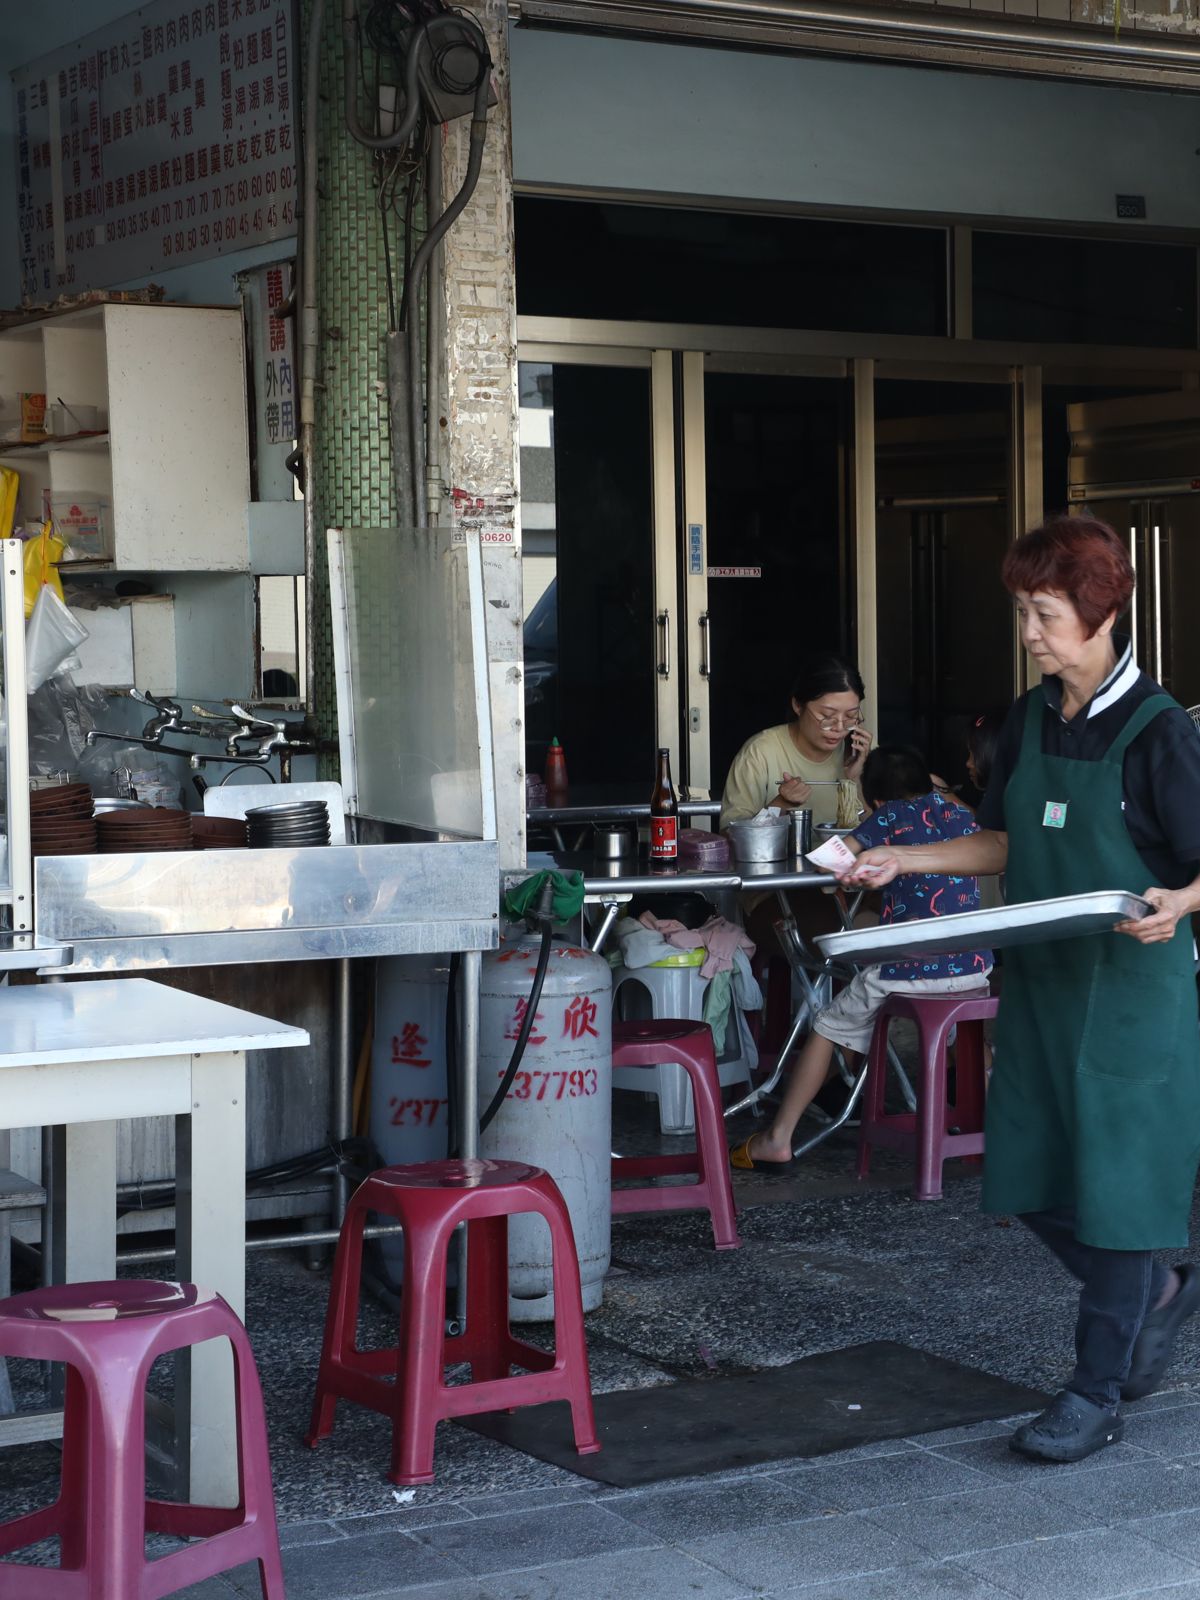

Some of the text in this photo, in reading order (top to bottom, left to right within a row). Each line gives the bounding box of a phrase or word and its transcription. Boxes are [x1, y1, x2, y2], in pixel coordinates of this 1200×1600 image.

[251, 175, 262, 197] 60
[265, 171, 277, 194] 60
[280, 166, 292, 189] 60
[212, 188, 222, 209] 70
[224, 183, 235, 207] 75
[237, 180, 248, 202] 60
[162, 203, 171, 225] 70
[174, 199, 183, 221] 70
[186, 195, 196, 218] 70
[199, 192, 208, 215] 70
[282, 200, 293, 225] 45
[128, 215, 137, 236] 35
[139, 211, 149, 232] 35
[151, 207, 160, 227] 40
[239, 213, 249, 236] 45
[253, 208, 263, 232] 45
[267, 204, 278, 227] 45
[200, 224, 210, 246] 50
[213, 220, 223, 242] 50
[225, 216, 237, 240] 60
[163, 235, 172, 256] 50
[175, 231, 184, 253] 50
[188, 228, 197, 251] 50
[265, 358, 280, 444] 外帶
